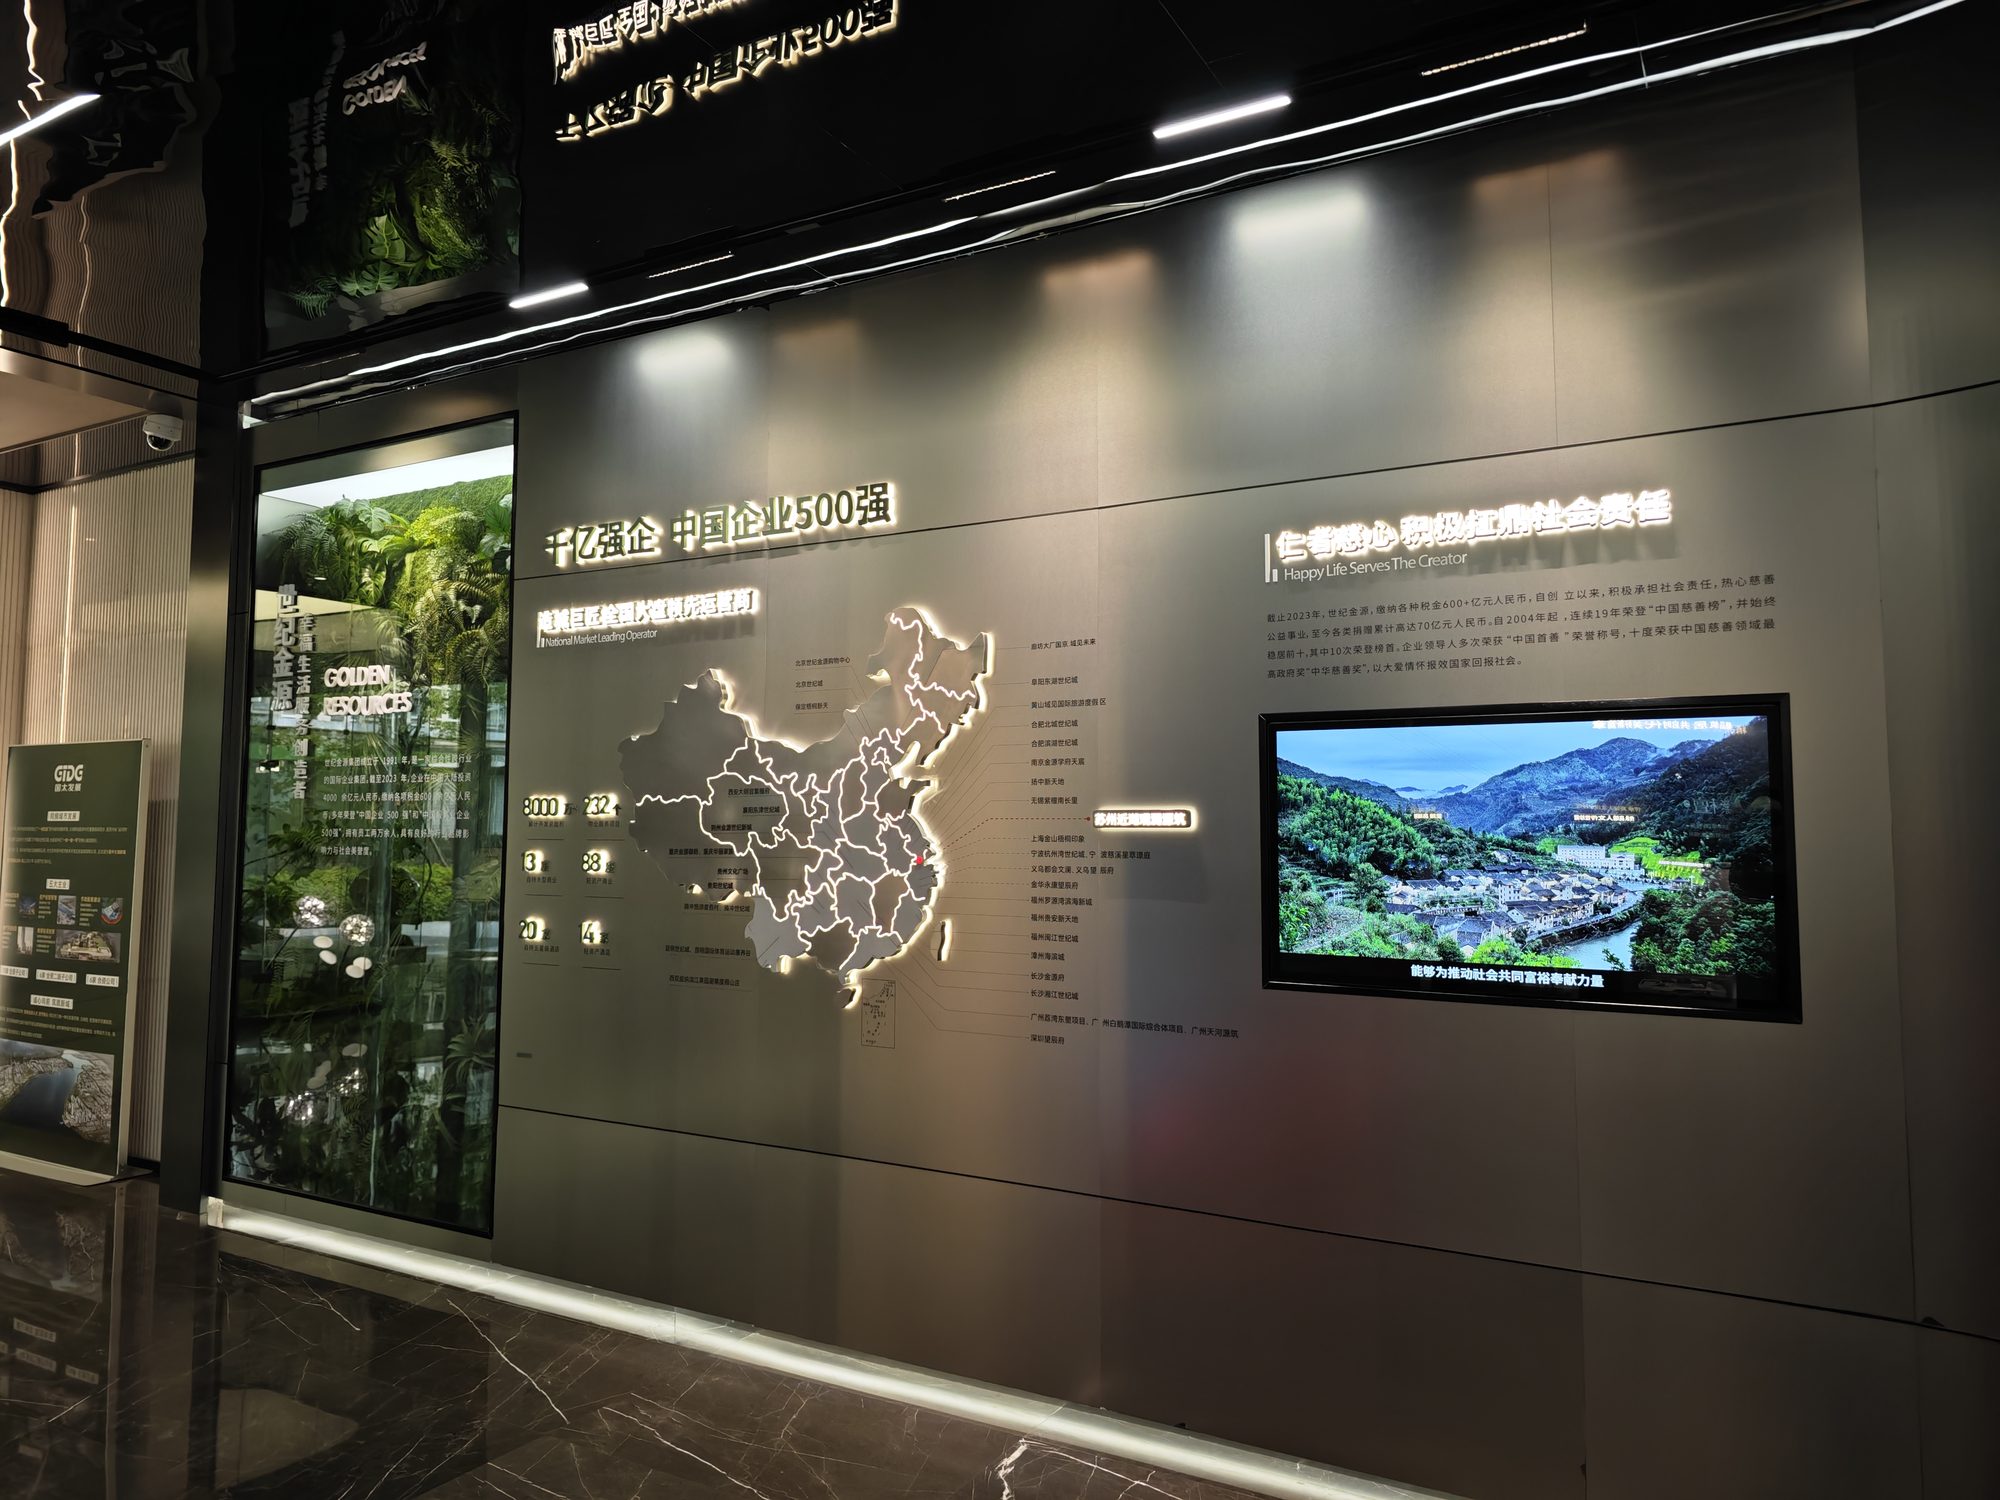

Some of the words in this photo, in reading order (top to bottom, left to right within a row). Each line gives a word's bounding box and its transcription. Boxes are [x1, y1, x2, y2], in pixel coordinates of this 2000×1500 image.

[545, 515, 657, 566] 千亿强企
[671, 482, 893, 550] 中国企业500强
[1284, 566, 1324, 582] Happy
[1326, 562, 1347, 578] Life
[1349, 559, 1390, 575] Serves
[1391, 556, 1416, 571] The
[1418, 552, 1468, 568] Creator
[272, 584, 299, 711] 世纪金源
[545, 635, 573, 647] National
[574, 633, 597, 645] Market
[598, 631, 625, 643] Leading
[626, 629, 658, 641] Operator
[324, 664, 391, 688] GOLDEN
[323, 692, 413, 716] RESOURCES
[1410, 964, 1605, 988] 能够为推动社会共同富裕奉献力量
